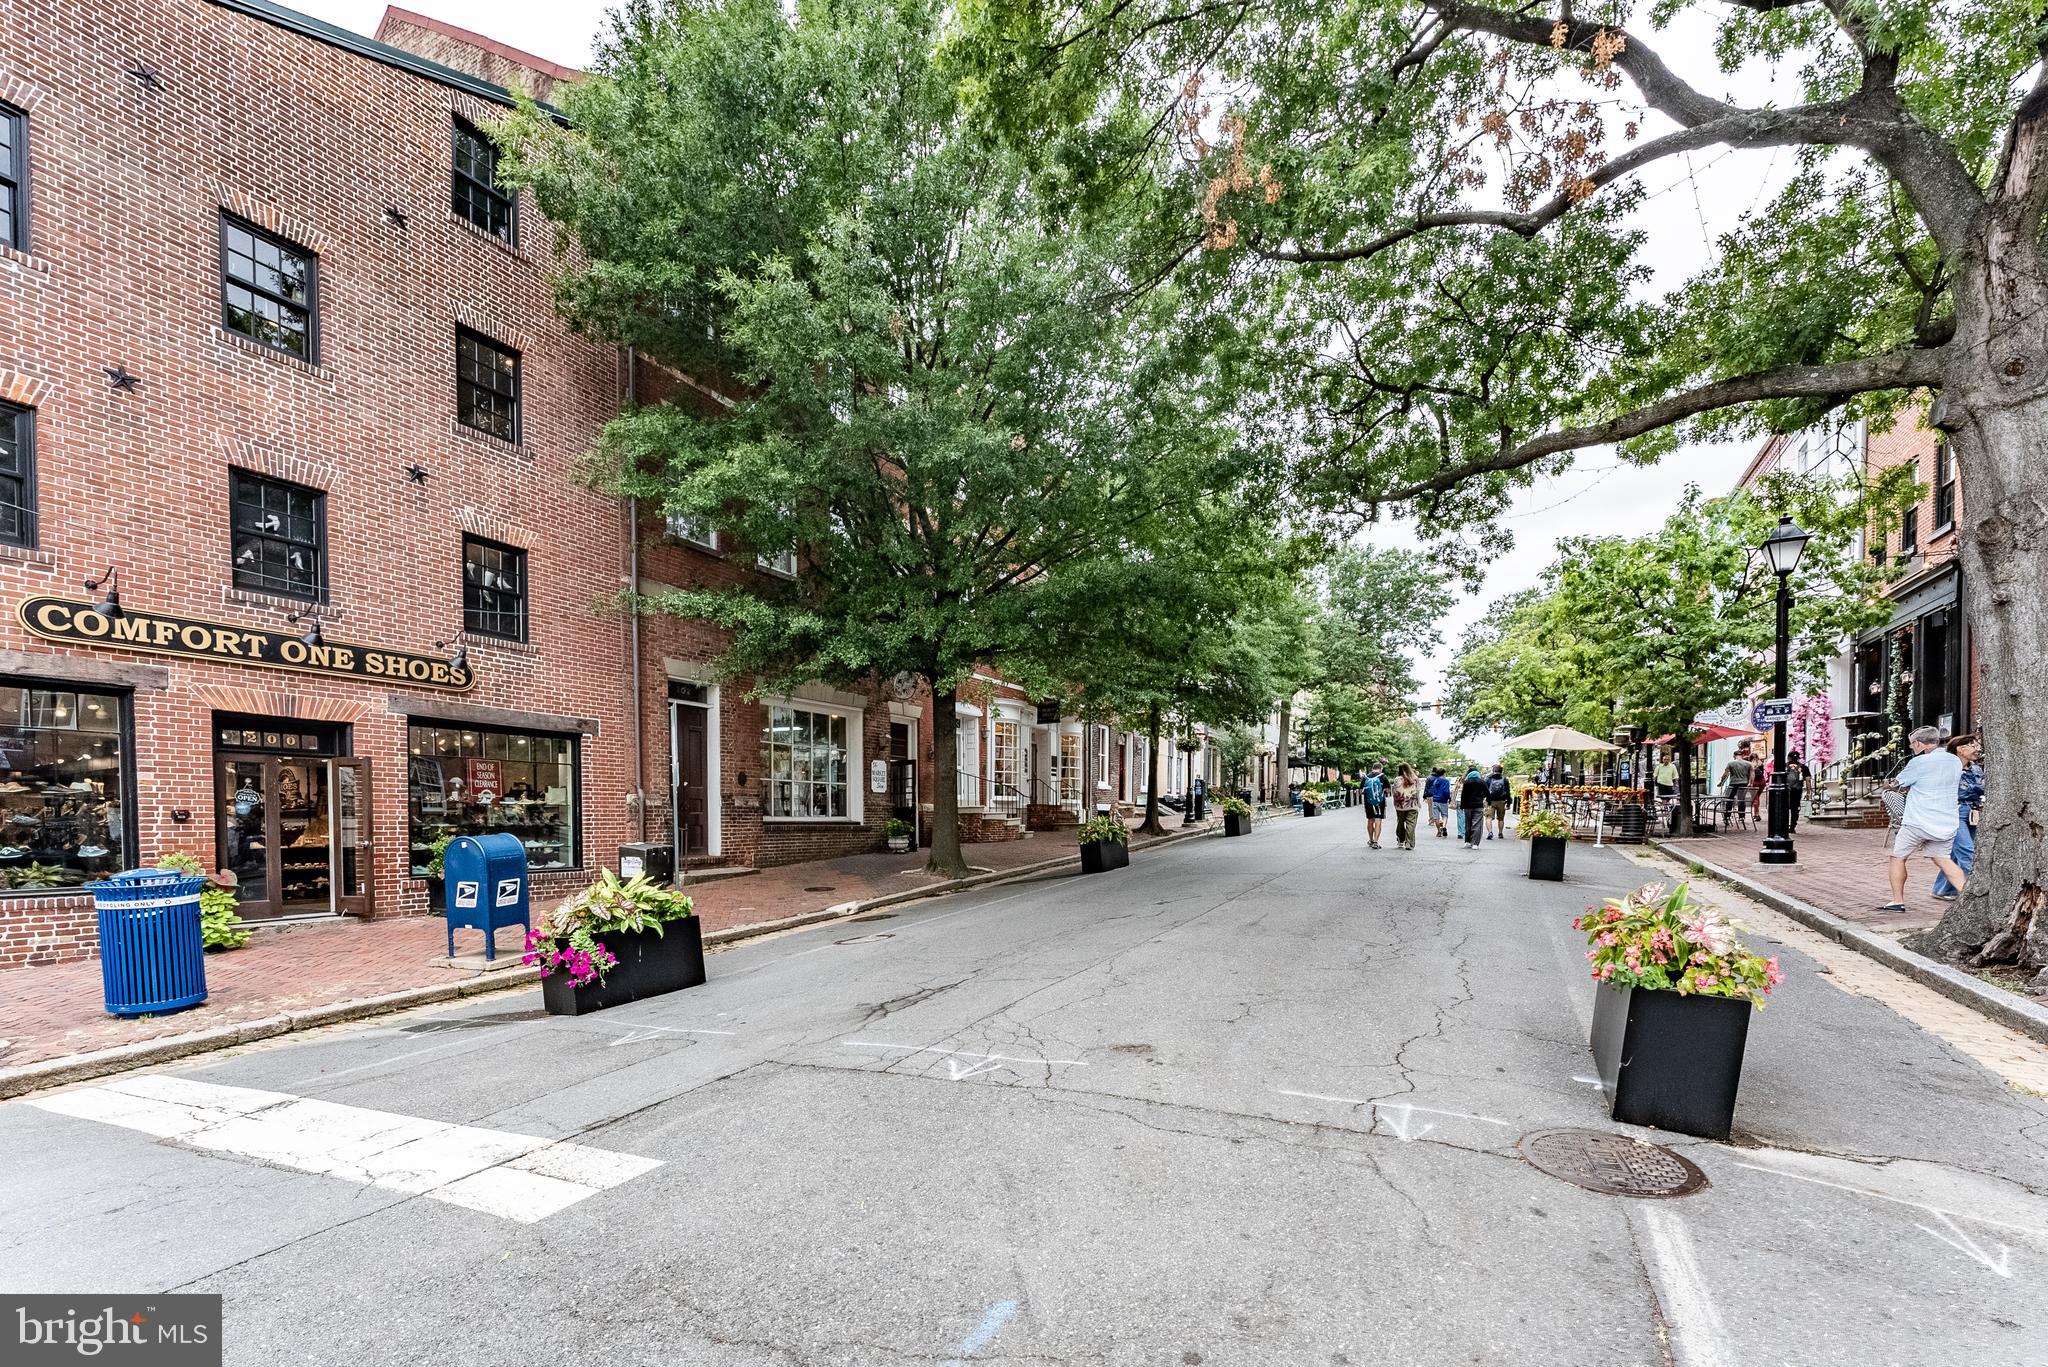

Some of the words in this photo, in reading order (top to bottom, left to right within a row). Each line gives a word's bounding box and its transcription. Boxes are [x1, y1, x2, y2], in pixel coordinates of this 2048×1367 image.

[37, 605, 268, 658] COMFORT
[280, 640, 355, 670] ONE
[365, 652, 467, 686] SHOES
[247, 734, 295, 745] 200
[488, 763, 495, 771] OF
[476, 771, 495, 779] SEASON
[474, 780, 498, 788] CLEARANCE
